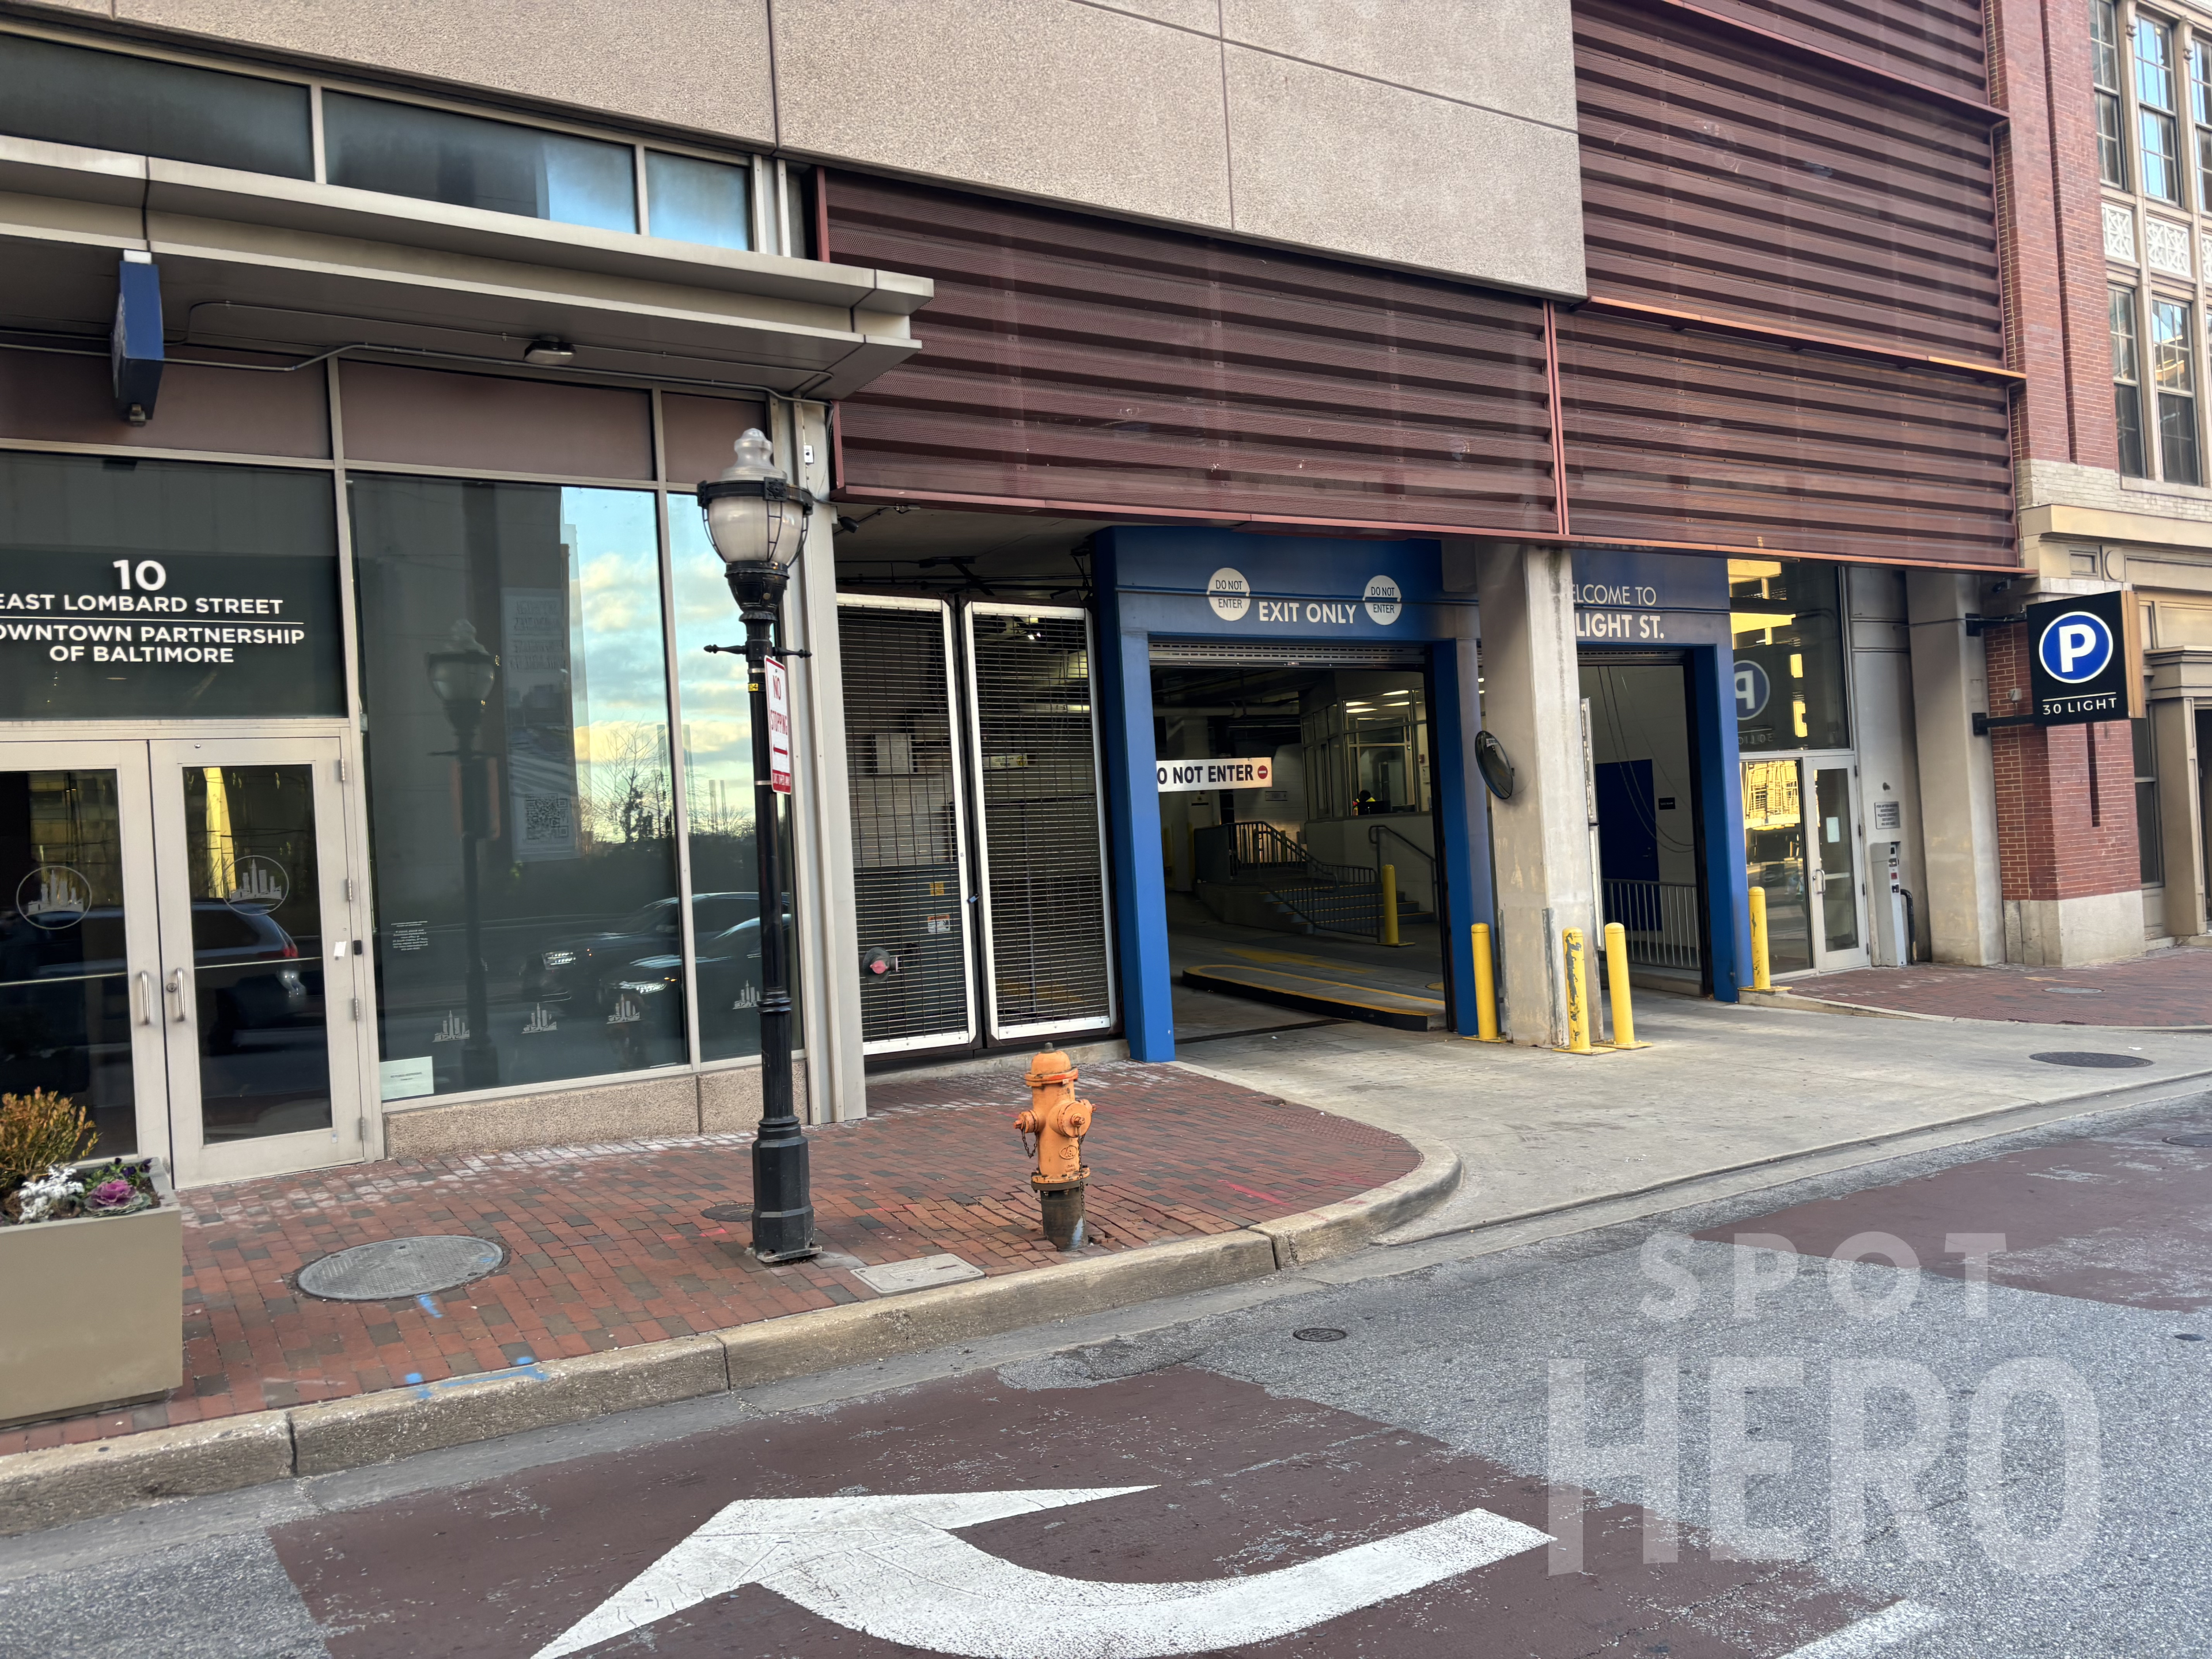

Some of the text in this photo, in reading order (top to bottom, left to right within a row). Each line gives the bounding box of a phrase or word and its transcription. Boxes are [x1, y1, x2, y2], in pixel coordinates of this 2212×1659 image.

[113, 559, 166, 591] 10
[1215, 580, 1243, 590] DO NOT
[1371, 586, 1395, 596] DO NOT
[1573, 584, 1657, 606] LCOME TO
[64, 594, 187, 612] LOMBARD
[196, 598, 283, 614] STREET
[1218, 599, 1243, 609] ENTER
[1259, 601, 1357, 624] EXIT ONLY
[1373, 604, 1395, 613] ENTER
[0, 624, 305, 644] WNTOWN PARTNERSHIP
[1575, 612, 1664, 639] LIGHT ST.
[50, 646, 234, 662] OF BALTIMORE
[2059, 624, 2096, 673] P
[773, 675, 781, 700] NO
[2042, 698, 2117, 715] 30 LIGHT
[1157, 764, 1253, 785] O NOT ENTER
